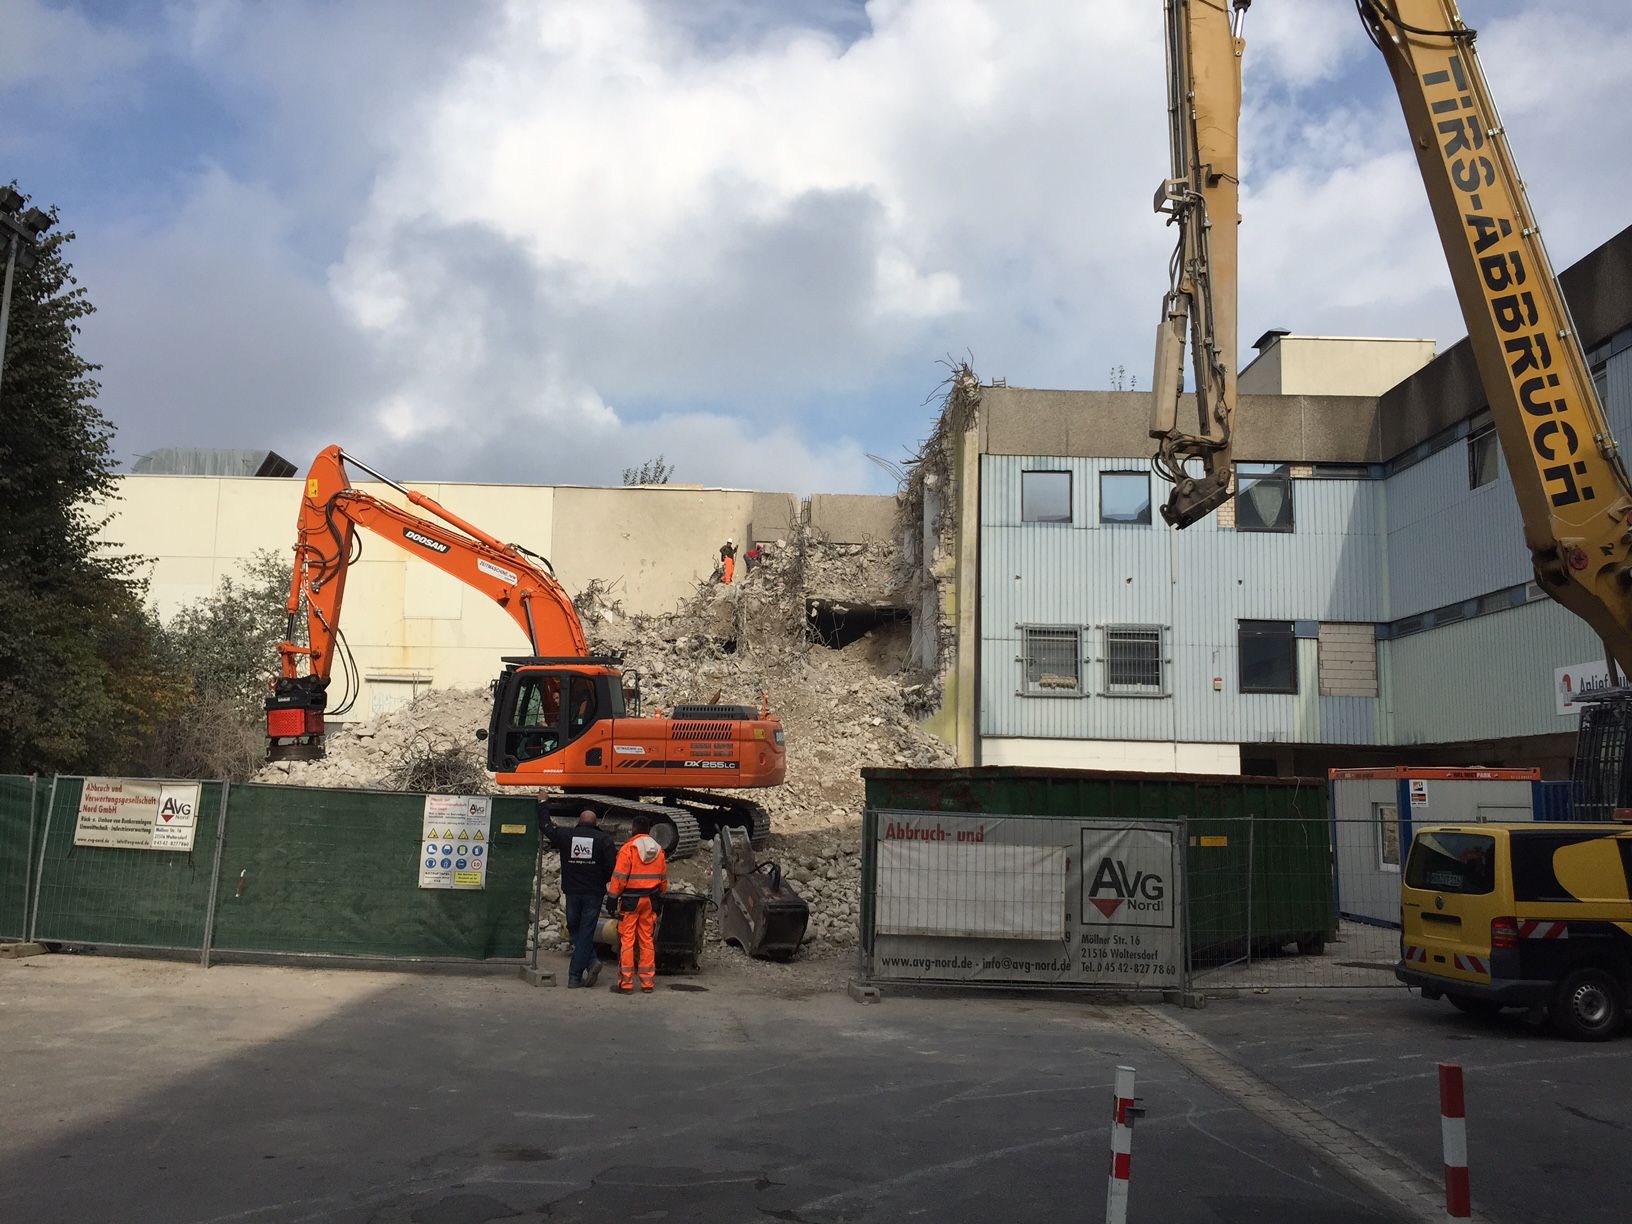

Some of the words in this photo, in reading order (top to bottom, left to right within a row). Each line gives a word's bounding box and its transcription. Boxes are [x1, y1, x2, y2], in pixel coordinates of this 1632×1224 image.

[1422, 55, 1596, 507] TIRS-ABBRUCH
[405, 530, 447, 552] DOOSAN
[111, 785, 122, 793] und
[85, 793, 156, 806] Verwertungsgesellschaft
[82, 804, 97, 813] Nord
[99, 805, 117, 814] GmbH
[161, 797, 191, 816] AVG
[957, 826, 984, 843] und
[1088, 856, 1164, 901] AVG
[1127, 899, 1161, 912] Nord
[1081, 934, 1110, 945] Möllner
[1113, 935, 1128, 945] Str.
[1130, 935, 1141, 946] 16
[1081, 948, 1108, 959] 21516
[1110, 948, 1158, 961] Woltersdorf
[881, 956, 973, 970] www.avg-nord.de
[982, 957, 1072, 973] info@avg-nord.de
[1081, 961, 1095, 972] Tel.
